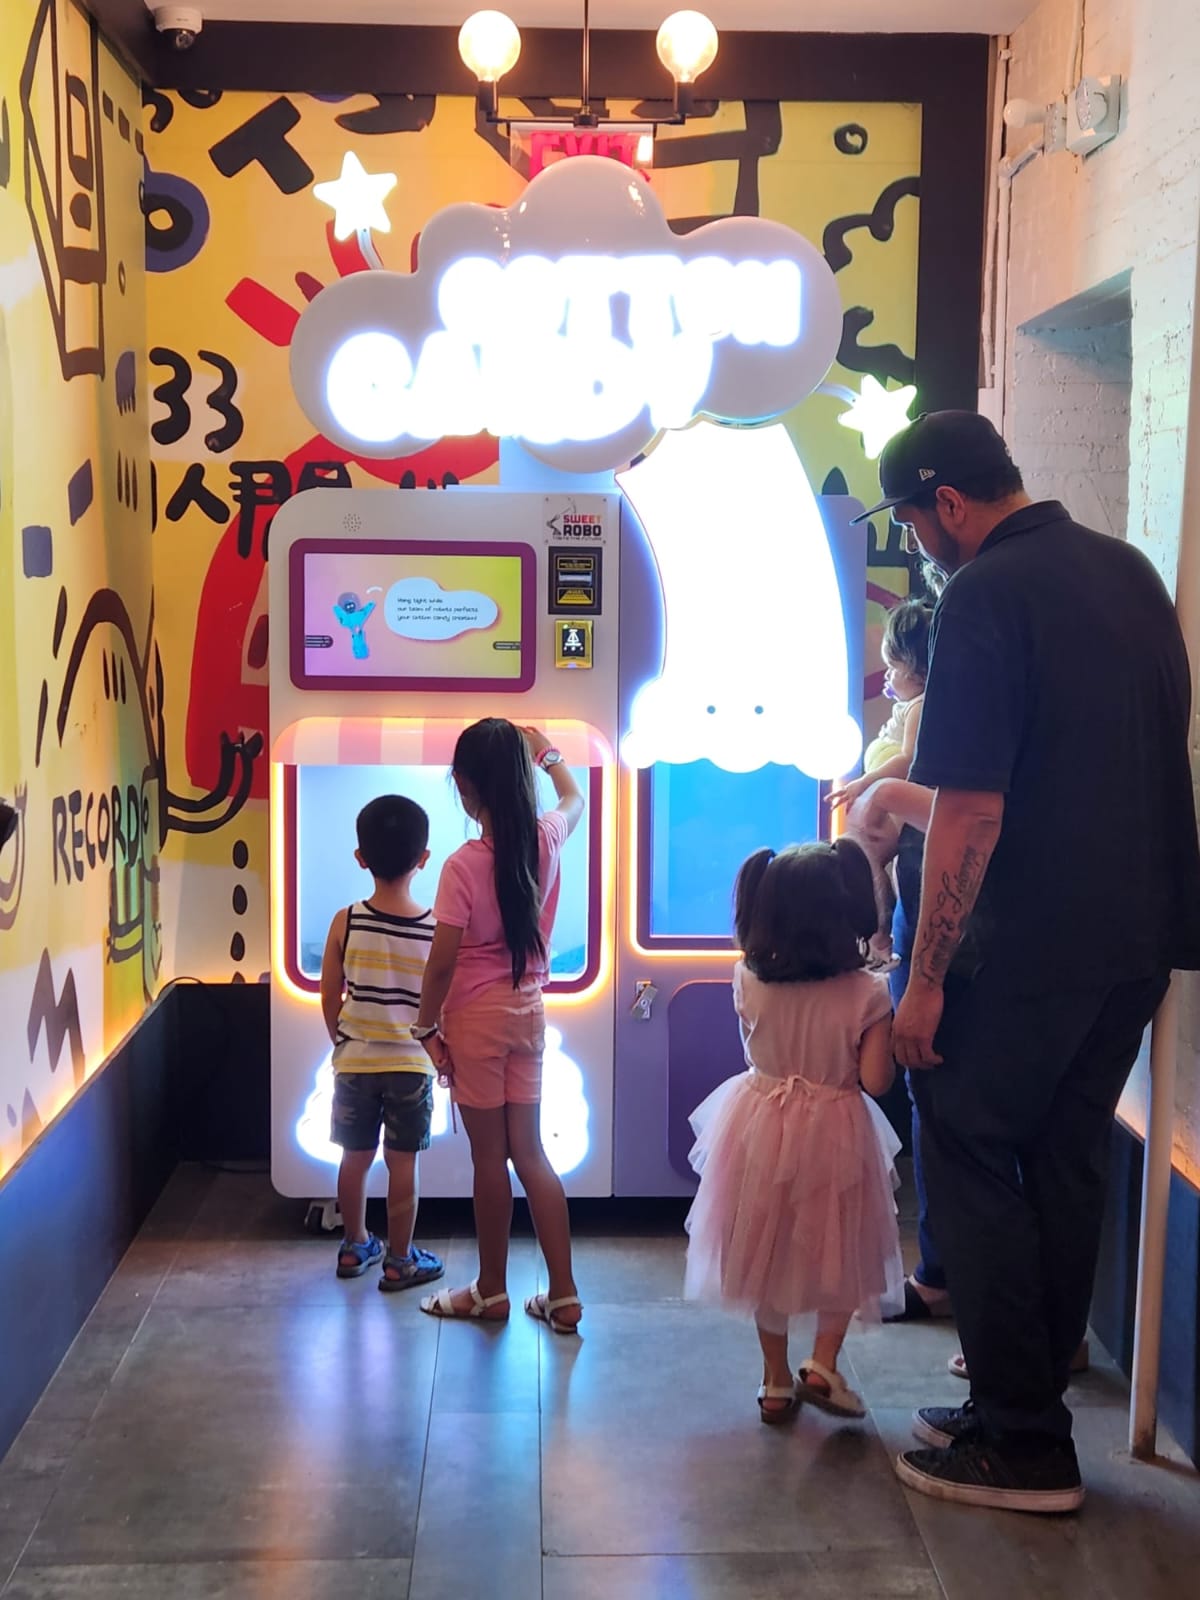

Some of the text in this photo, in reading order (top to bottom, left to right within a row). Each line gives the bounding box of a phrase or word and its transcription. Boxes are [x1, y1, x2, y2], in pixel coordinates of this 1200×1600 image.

[563, 514, 602, 524] SWEET
[563, 524, 602, 536] ROBO
[52, 784, 141, 886] RECORD
